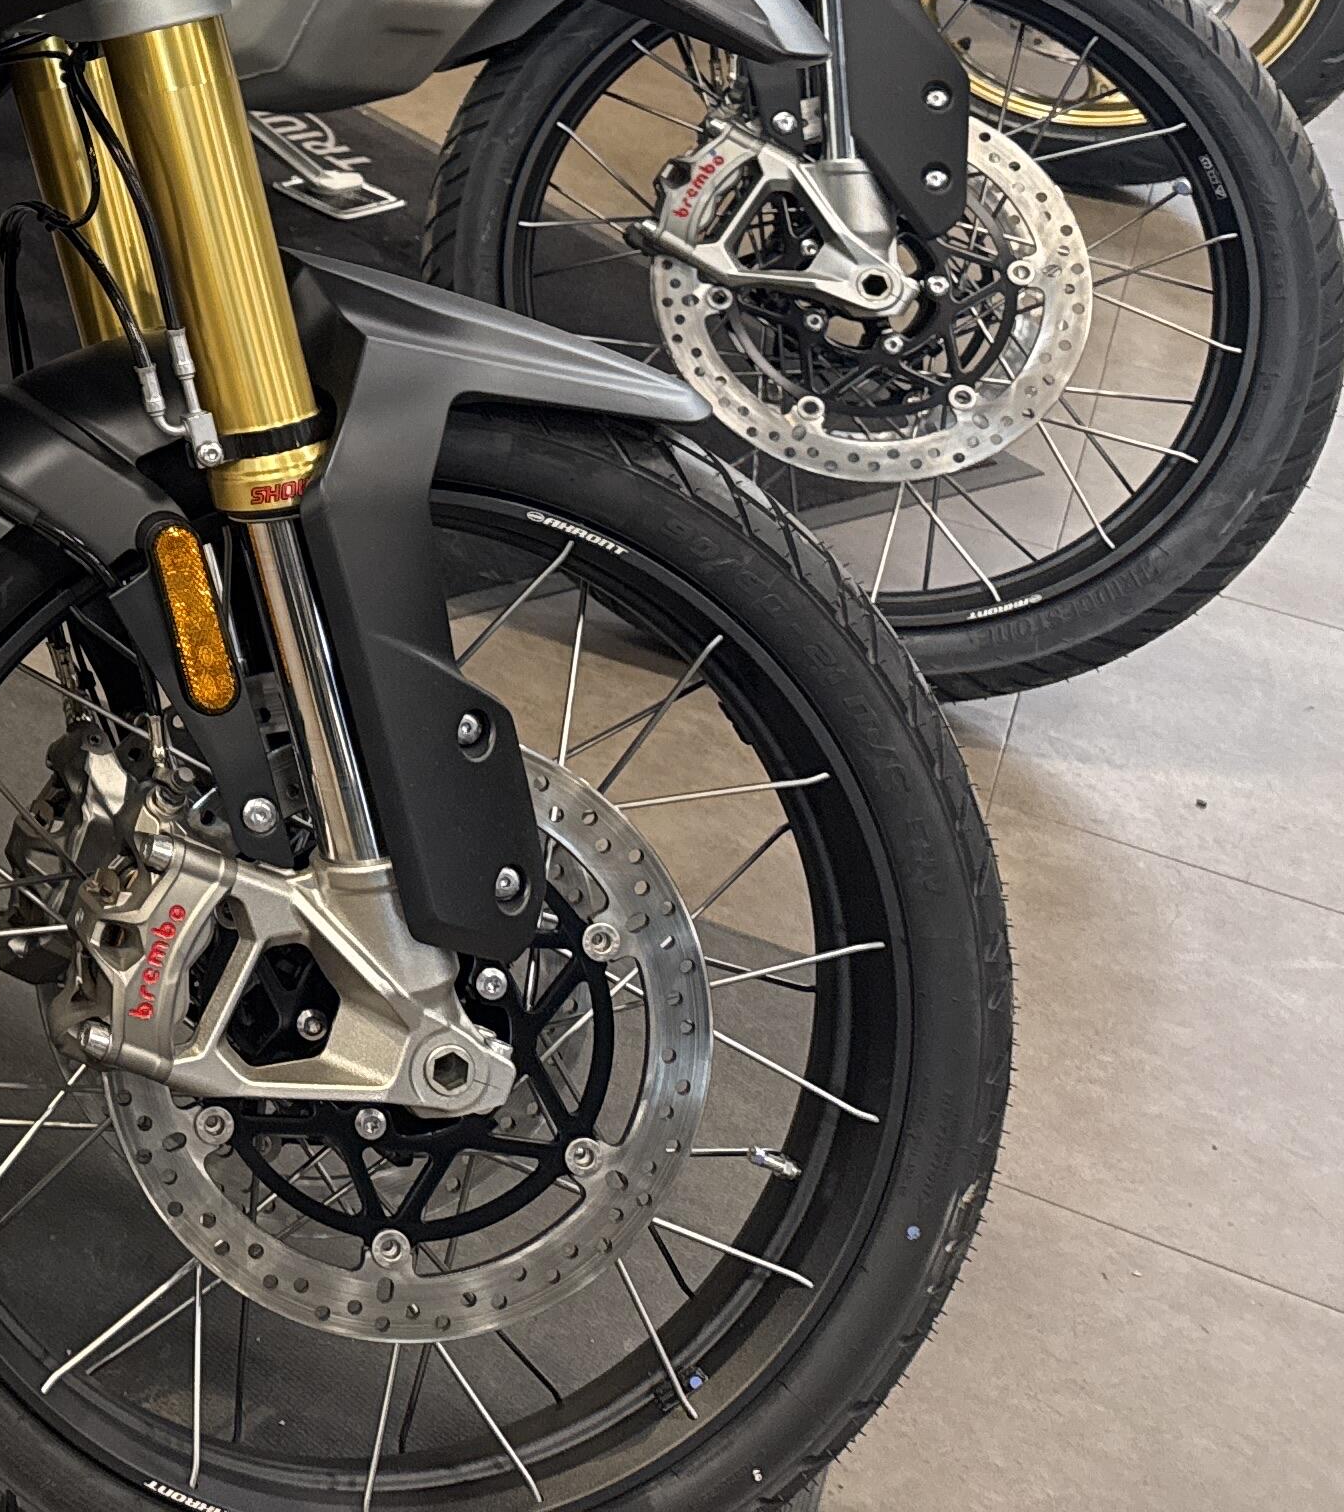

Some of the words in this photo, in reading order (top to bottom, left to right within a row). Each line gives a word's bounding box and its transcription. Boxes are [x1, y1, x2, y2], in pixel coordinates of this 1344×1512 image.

[248, 110, 372, 171] TRIU
[672, 155, 725, 219] brembo
[251, 477, 309, 505] SHO
[543, 517, 629, 555] AKRONT
[128, 904, 186, 1021] brembo
